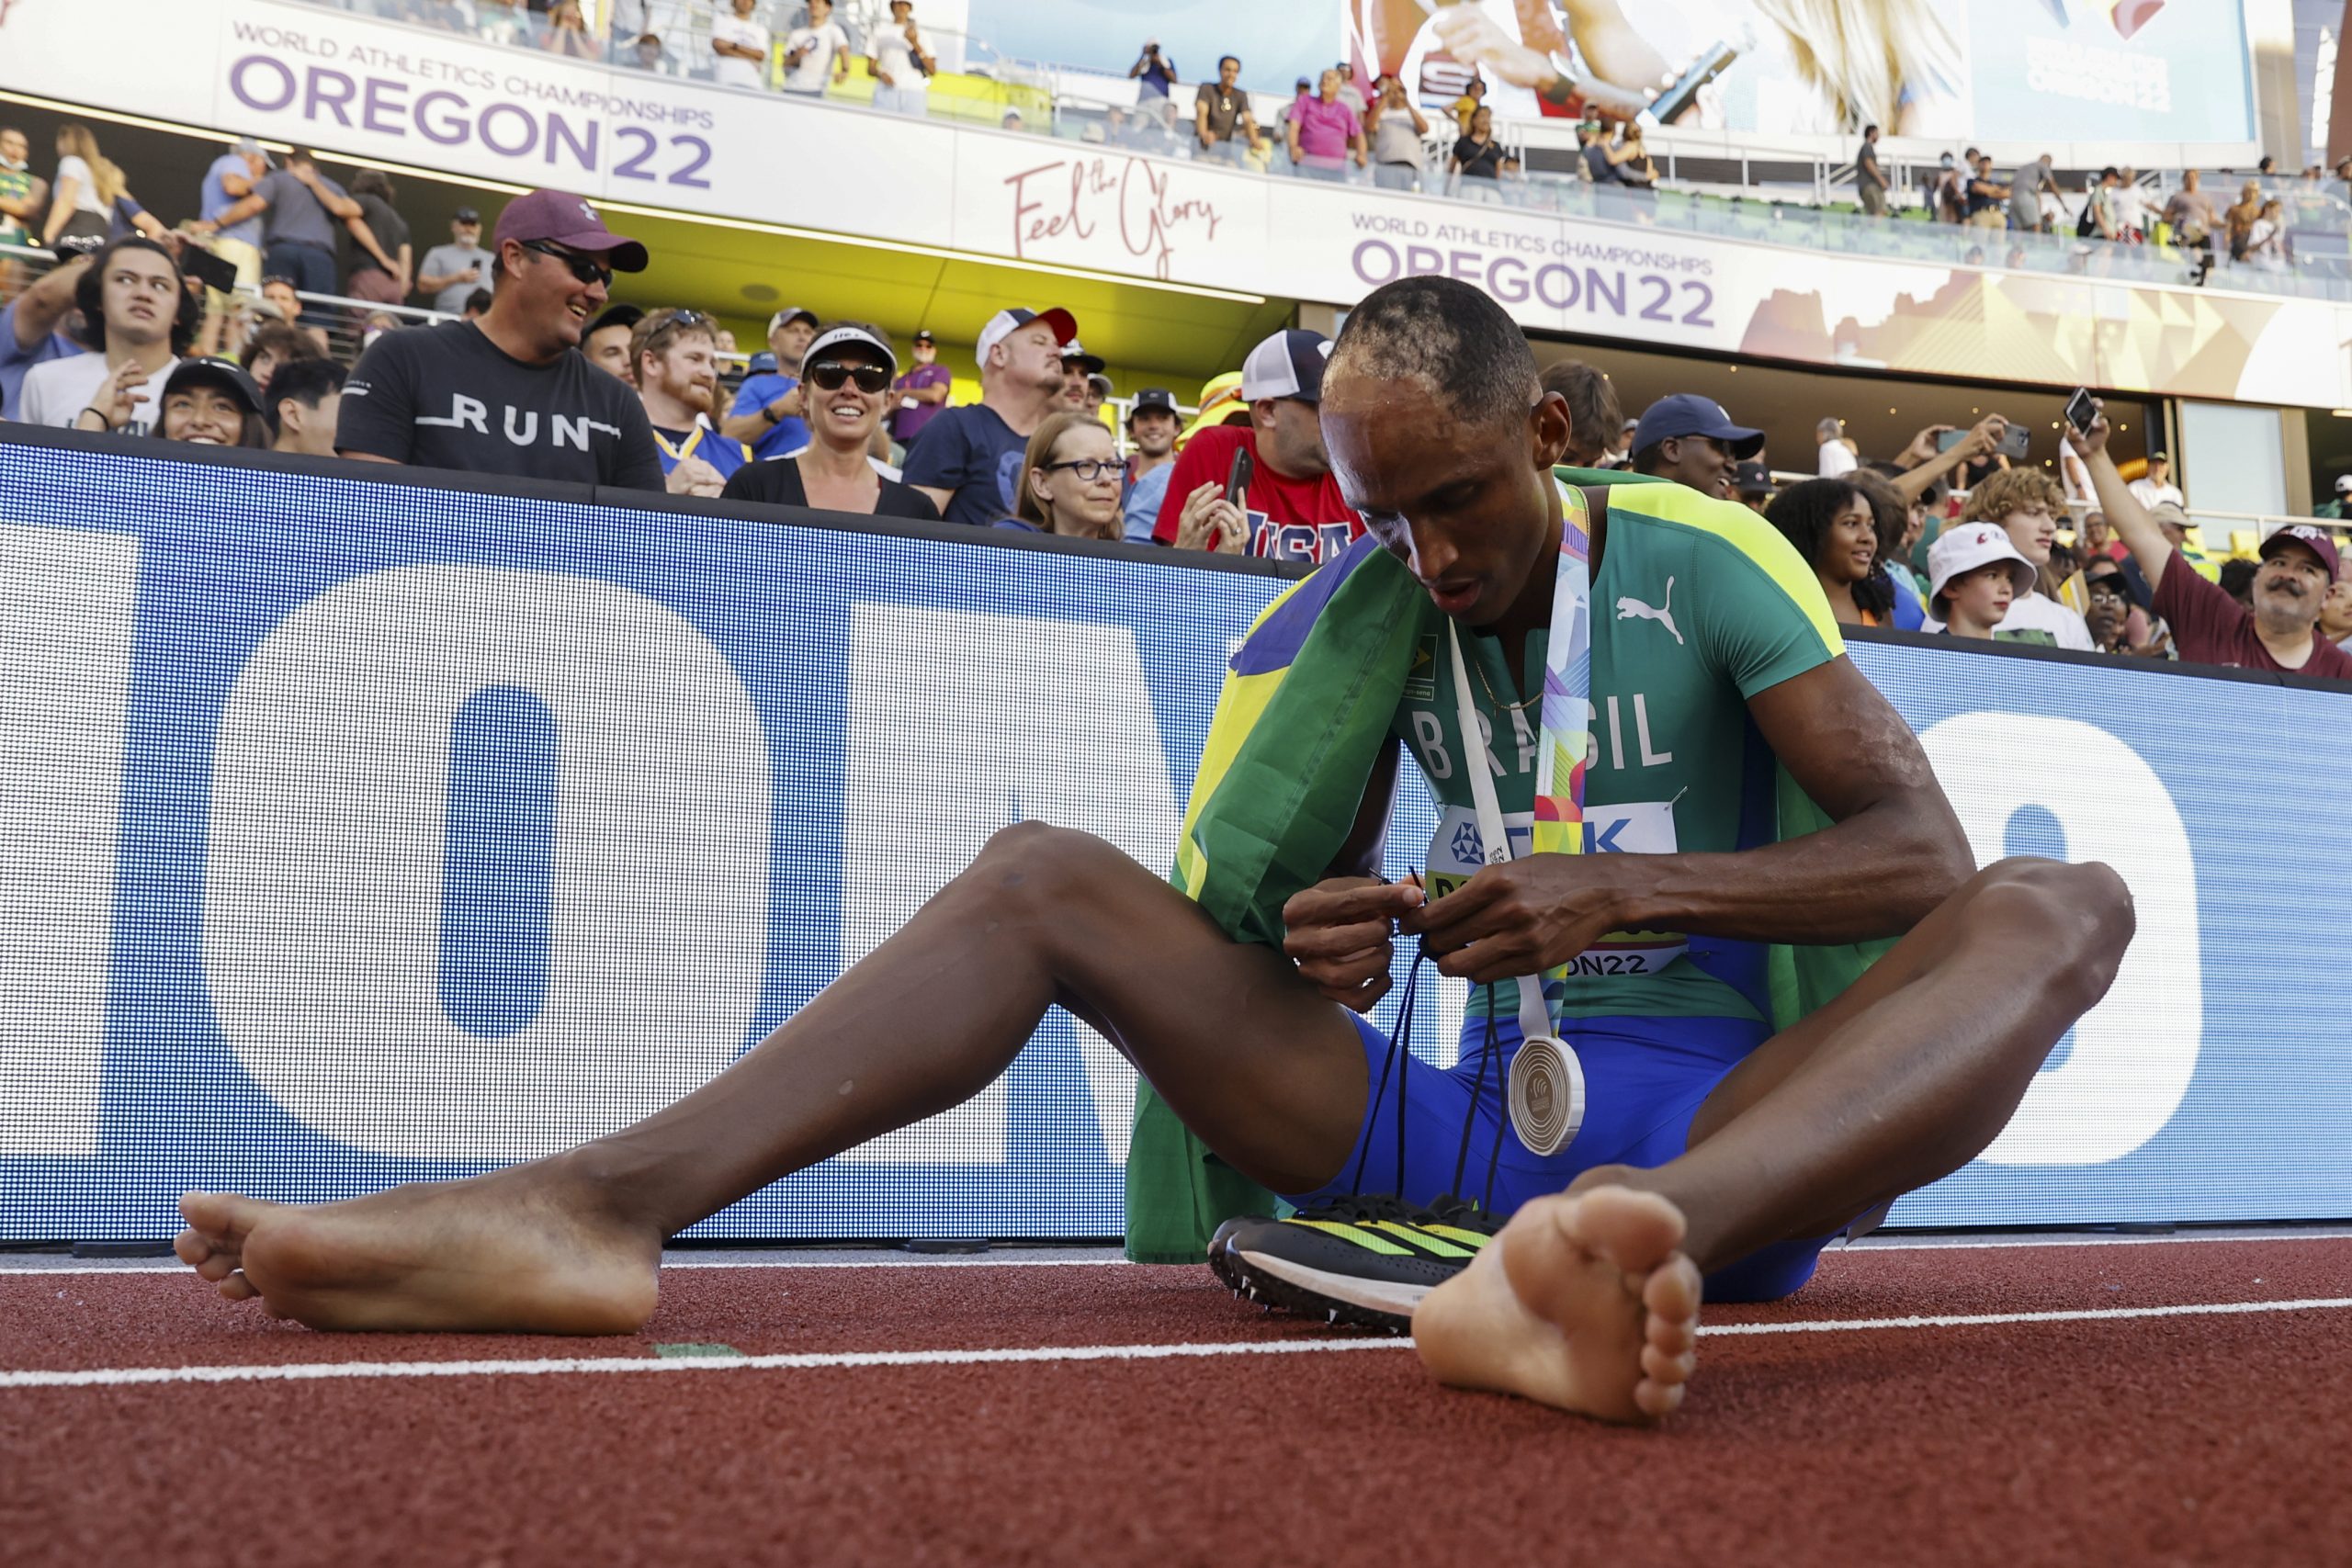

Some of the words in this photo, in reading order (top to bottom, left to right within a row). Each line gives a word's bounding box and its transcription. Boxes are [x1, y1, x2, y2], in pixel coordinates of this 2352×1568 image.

[230, 54, 713, 190] OREGON22
[232, 20, 338, 58] WORLD
[347, 44, 496, 90] ATHLETICS
[503, 75, 715, 130] CHAMPIONSHIPS
[1003, 161, 1096, 259] Feel
[1090, 159, 1117, 195] the
[1119, 155, 1223, 281] Glory
[1351, 212, 1430, 238] WORLD
[1435, 223, 1546, 254] ATHLETICS
[1551, 239, 1713, 276] CHAMPIONSHIPS
[1351, 239, 1715, 328] OREGON22
[451, 392, 591, 452] RUN
